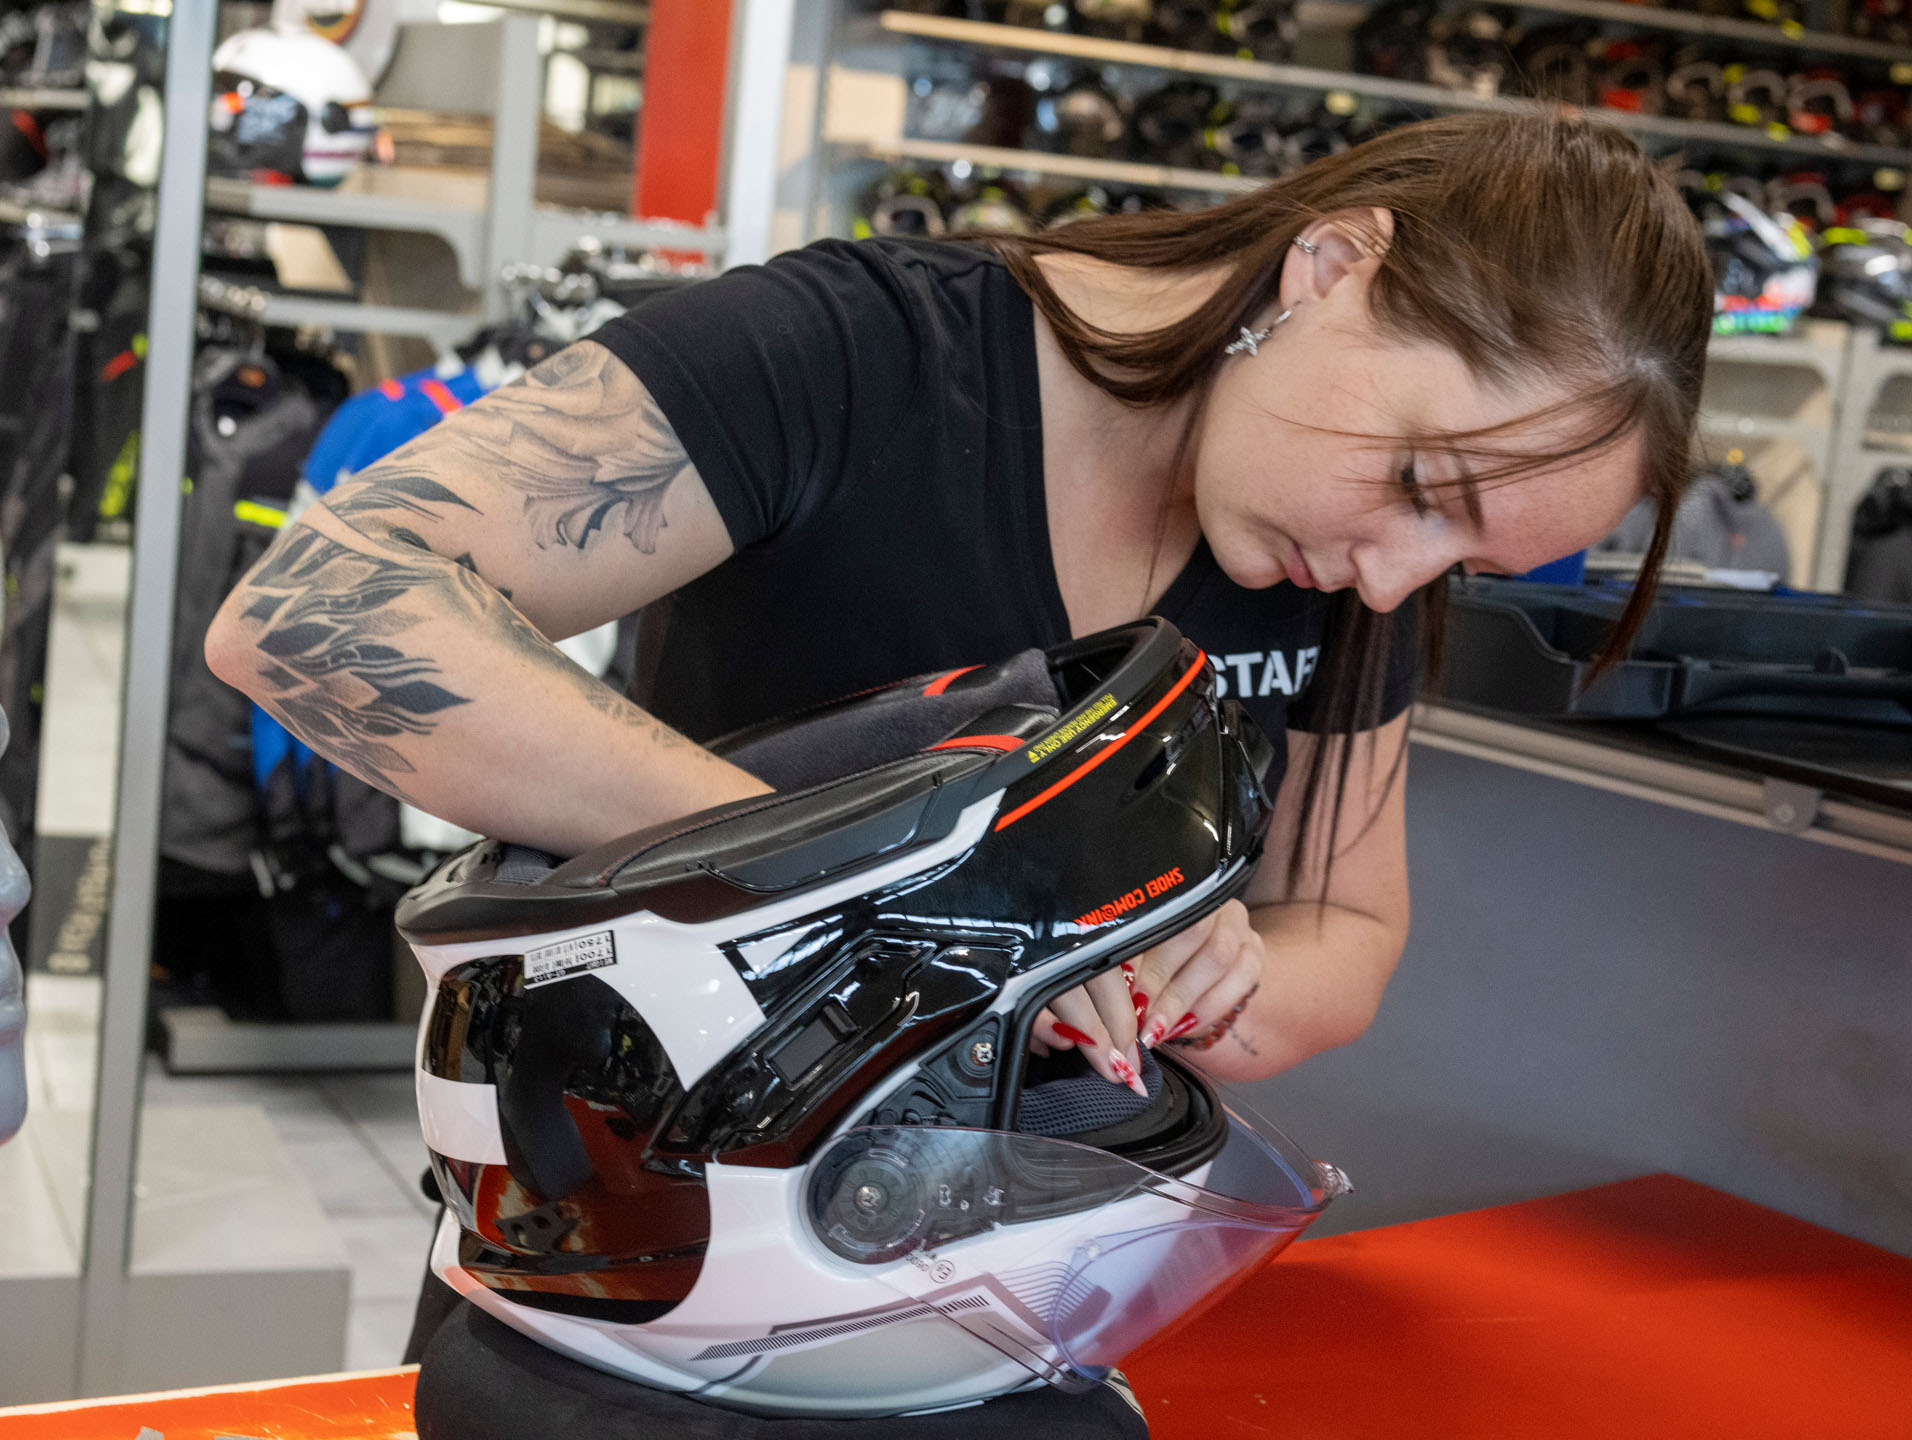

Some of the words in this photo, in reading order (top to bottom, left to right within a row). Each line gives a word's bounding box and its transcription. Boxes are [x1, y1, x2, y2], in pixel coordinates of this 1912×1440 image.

[1207, 646, 1321, 698] STAF
[1076, 697, 1118, 733] EMERGENCY
[1040, 741, 1061, 758] ONLY
[1060, 729, 1078, 744] USE
[1145, 866, 1185, 898] SHOEI
